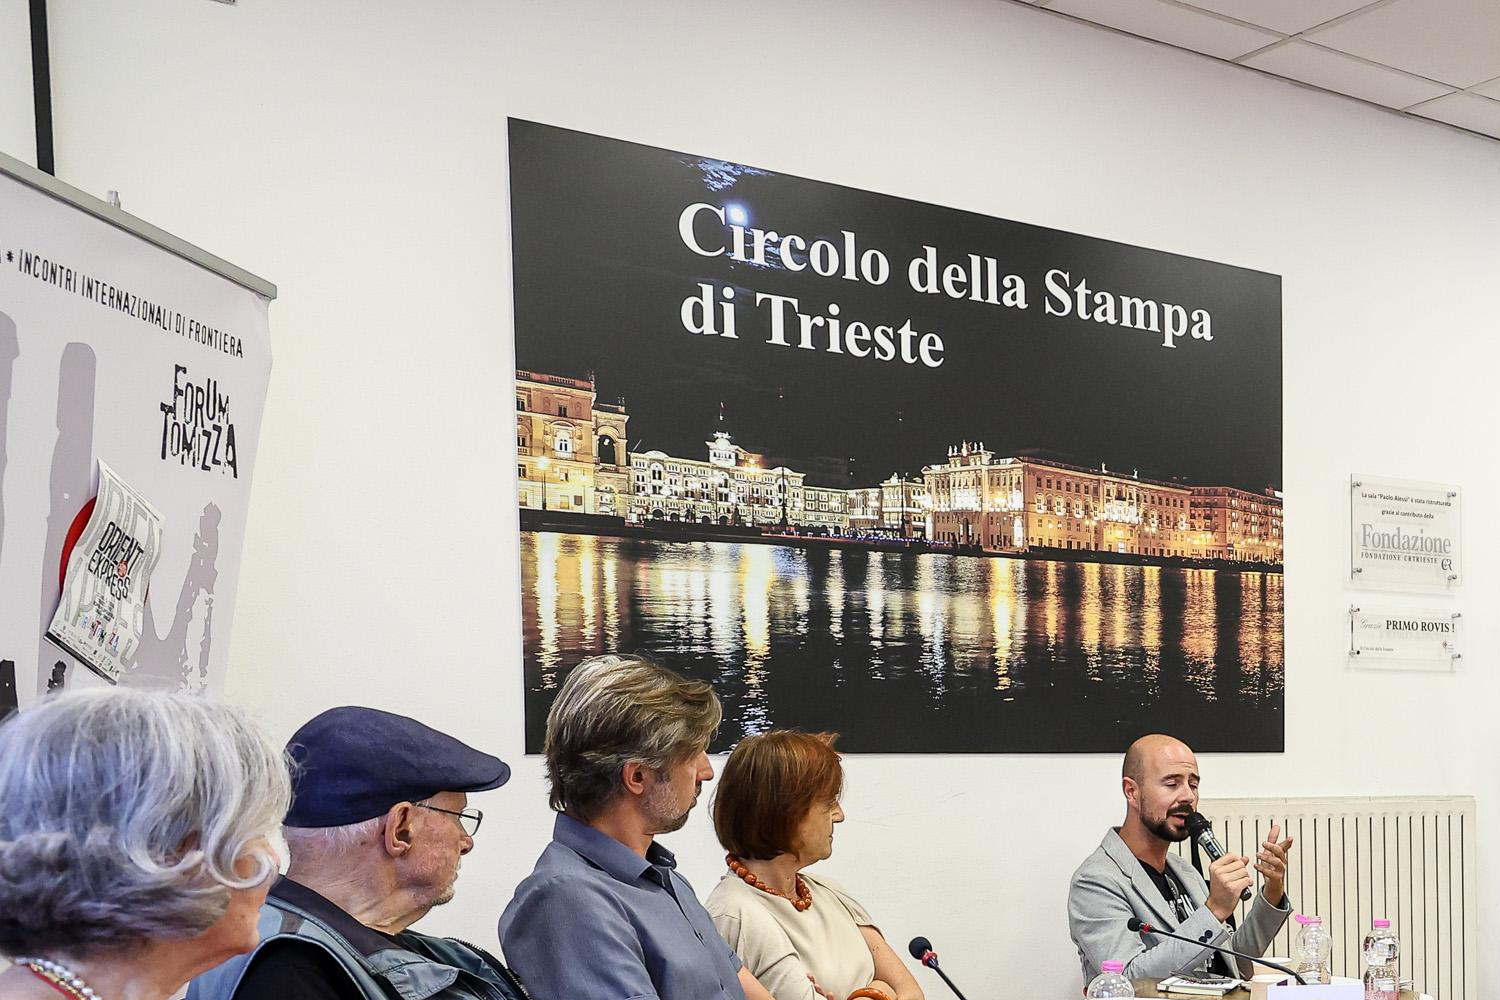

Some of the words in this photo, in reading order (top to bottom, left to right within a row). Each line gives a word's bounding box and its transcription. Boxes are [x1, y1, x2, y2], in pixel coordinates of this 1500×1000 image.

[677, 200, 891, 286] Circolo
[907, 245, 1029, 311] della
[1042, 267, 1215, 349] Stampa
[18, 249, 77, 293] INCONTRI
[81, 274, 173, 331] INTERNAZIONALI
[175, 313, 186, 335] DI
[188, 318, 244, 359] FRONTIERA
[679, 282, 740, 339] di
[755, 289, 945, 368] Trieste
[98, 521, 144, 576] ORIENT
[1361, 523, 1452, 554] Fondazione
[1361, 551, 1400, 561] FONDAZIONE
[88, 549, 131, 600] EXPRESS
[1386, 620, 1419, 631] PRIMO
[1421, 621, 1450, 633] ROVIS
